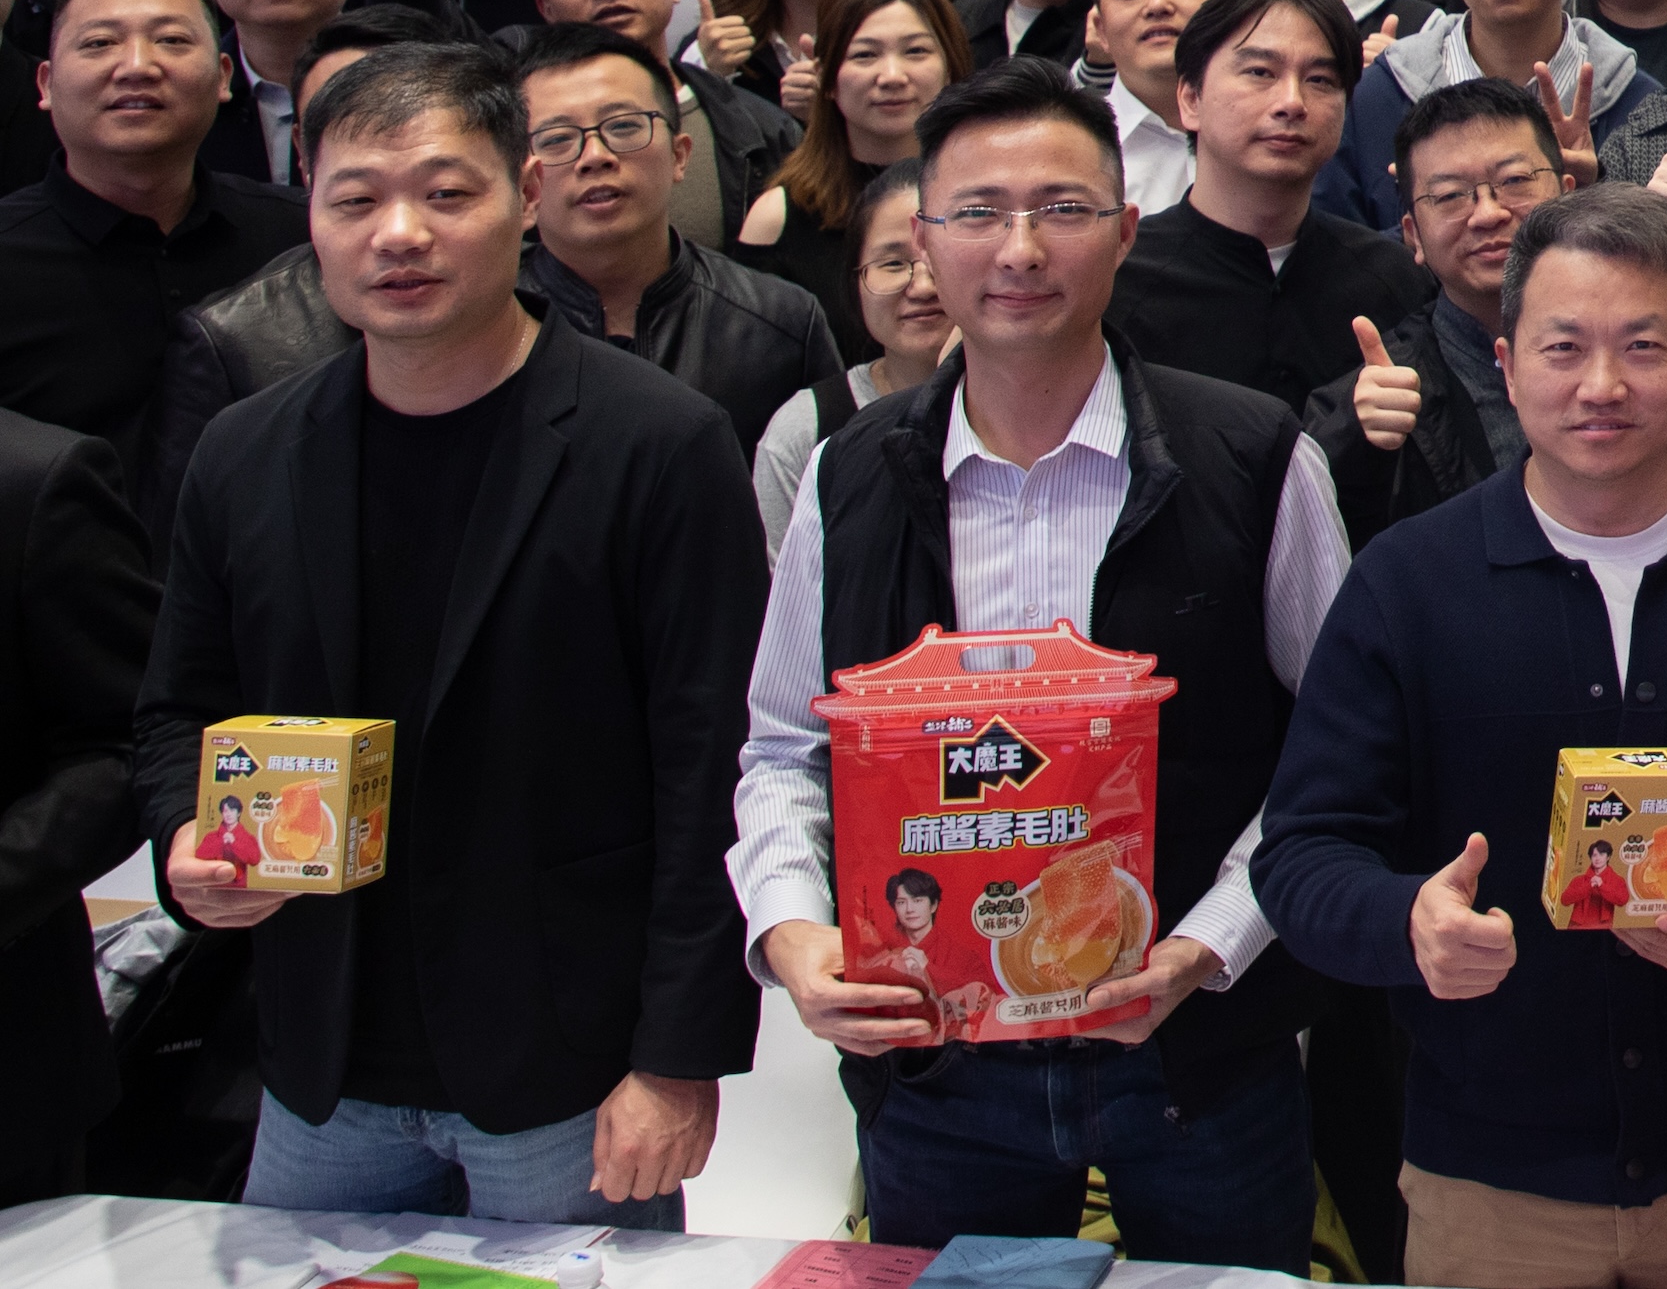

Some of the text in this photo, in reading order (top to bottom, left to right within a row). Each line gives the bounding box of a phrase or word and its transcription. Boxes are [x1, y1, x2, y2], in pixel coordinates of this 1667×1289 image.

[217, 755, 251, 771] 大魔王
[267, 755, 339, 773] 麻酱素毛肚
[949, 743, 1023, 775] 大魔王
[1588, 801, 1623, 816] 大魔王
[902, 807, 1088, 854] 麻酱素毛肚
[982, 915, 1021, 930] 麻酱味
[1009, 994, 1081, 1018] 芝麻酱只用
